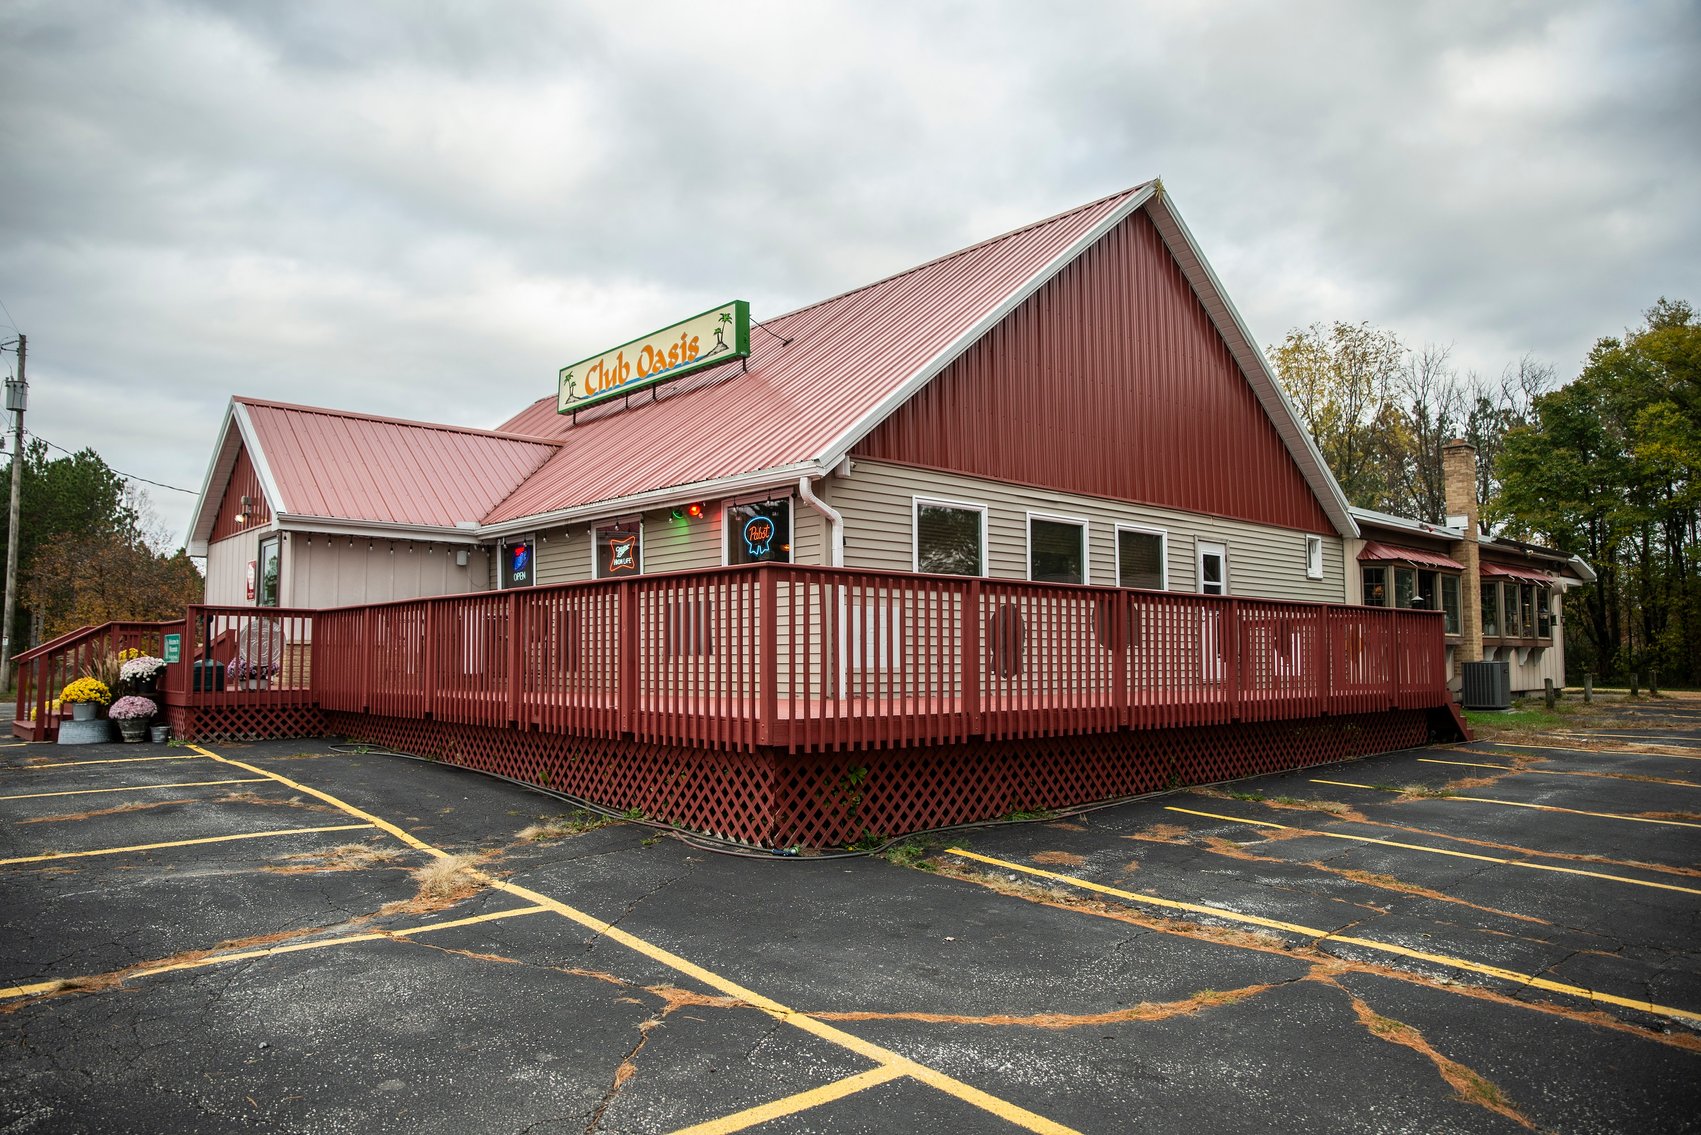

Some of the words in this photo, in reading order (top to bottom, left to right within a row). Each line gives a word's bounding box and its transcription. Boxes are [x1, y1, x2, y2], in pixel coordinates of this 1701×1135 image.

[585, 351, 631, 396] Club
[637, 331, 700, 379] Oasis
[749, 524, 770, 541] Pabst
[513, 571, 526, 582] OPEN
